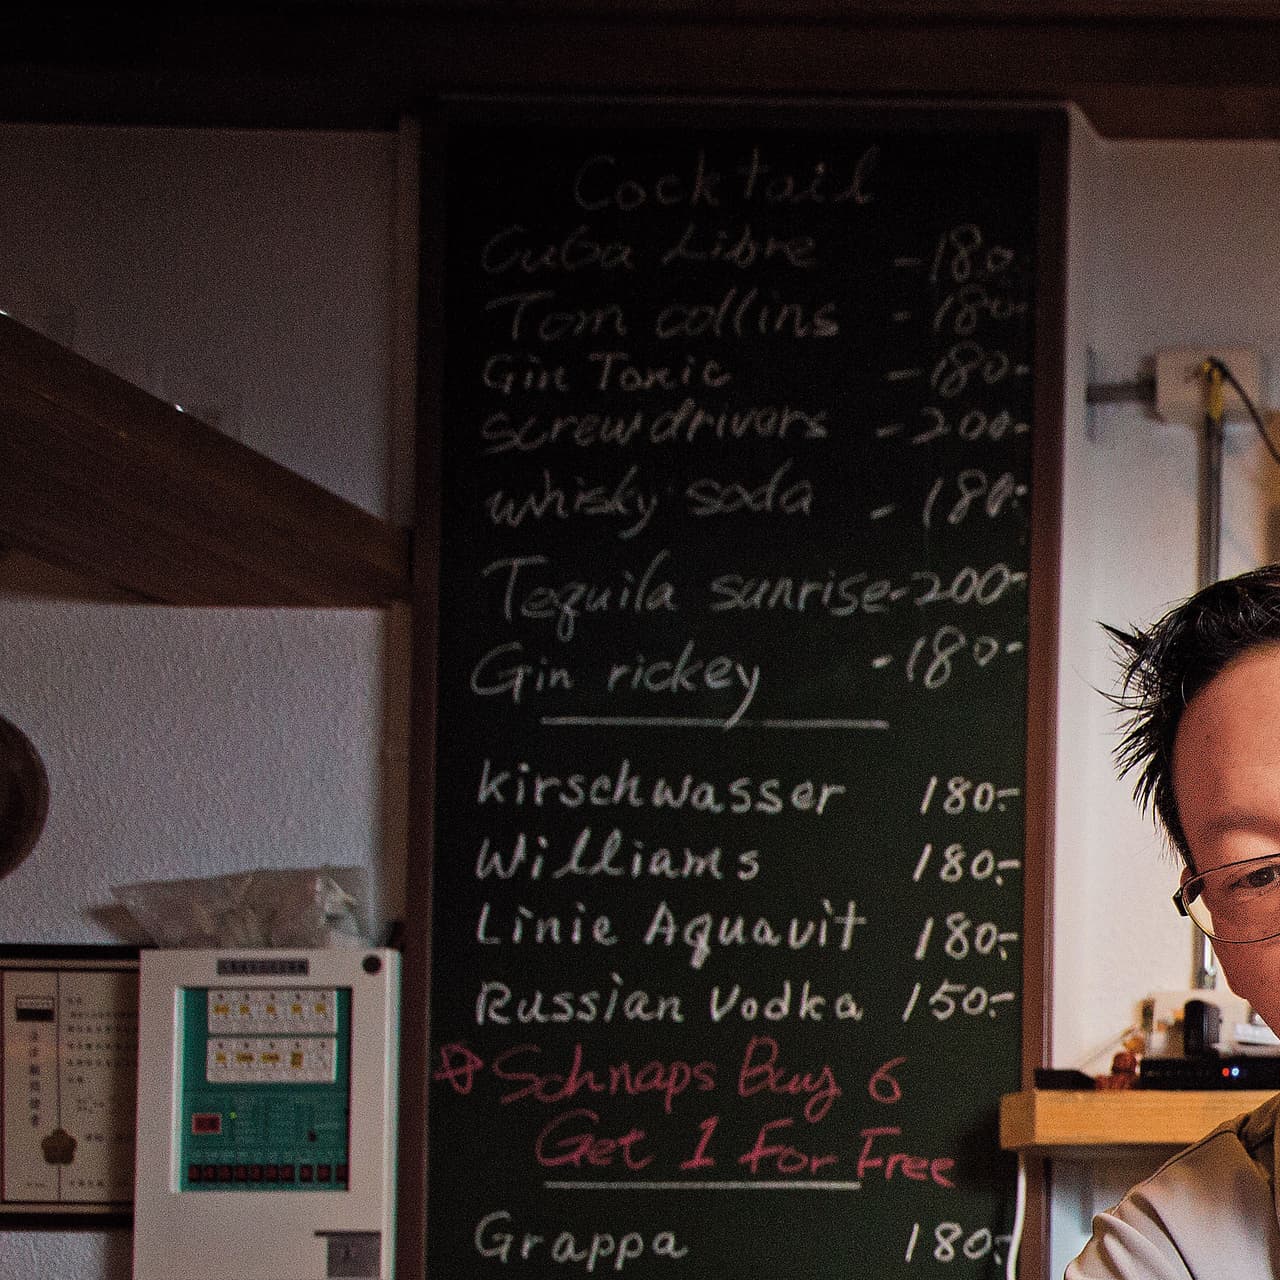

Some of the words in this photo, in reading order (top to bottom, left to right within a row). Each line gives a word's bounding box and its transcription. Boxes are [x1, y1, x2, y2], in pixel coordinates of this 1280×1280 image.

[574, 145, 880, 212] Cocktail
[483, 288, 627, 341] Tom
[483, 352, 570, 393] Gin
[482, 549, 676, 643] Tequila
[470, 641, 574, 704] Gin
[608, 639, 760, 730] rickey
[475, 827, 761, 882] Williams
[477, 902, 619, 946] Linie
[644, 899, 868, 970] Aquavit
[476, 973, 684, 1027] Russian
[709, 981, 864, 1024] Vodka
[492, 1041, 718, 1115] Schnaps
[737, 1035, 843, 1123] Buy
[868, 1056, 908, 1103] 6
[534, 1108, 653, 1172] Get
[680, 1115, 719, 1171] 1
[856, 1126, 957, 1189] Free
[474, 1211, 690, 1268] Grappa
